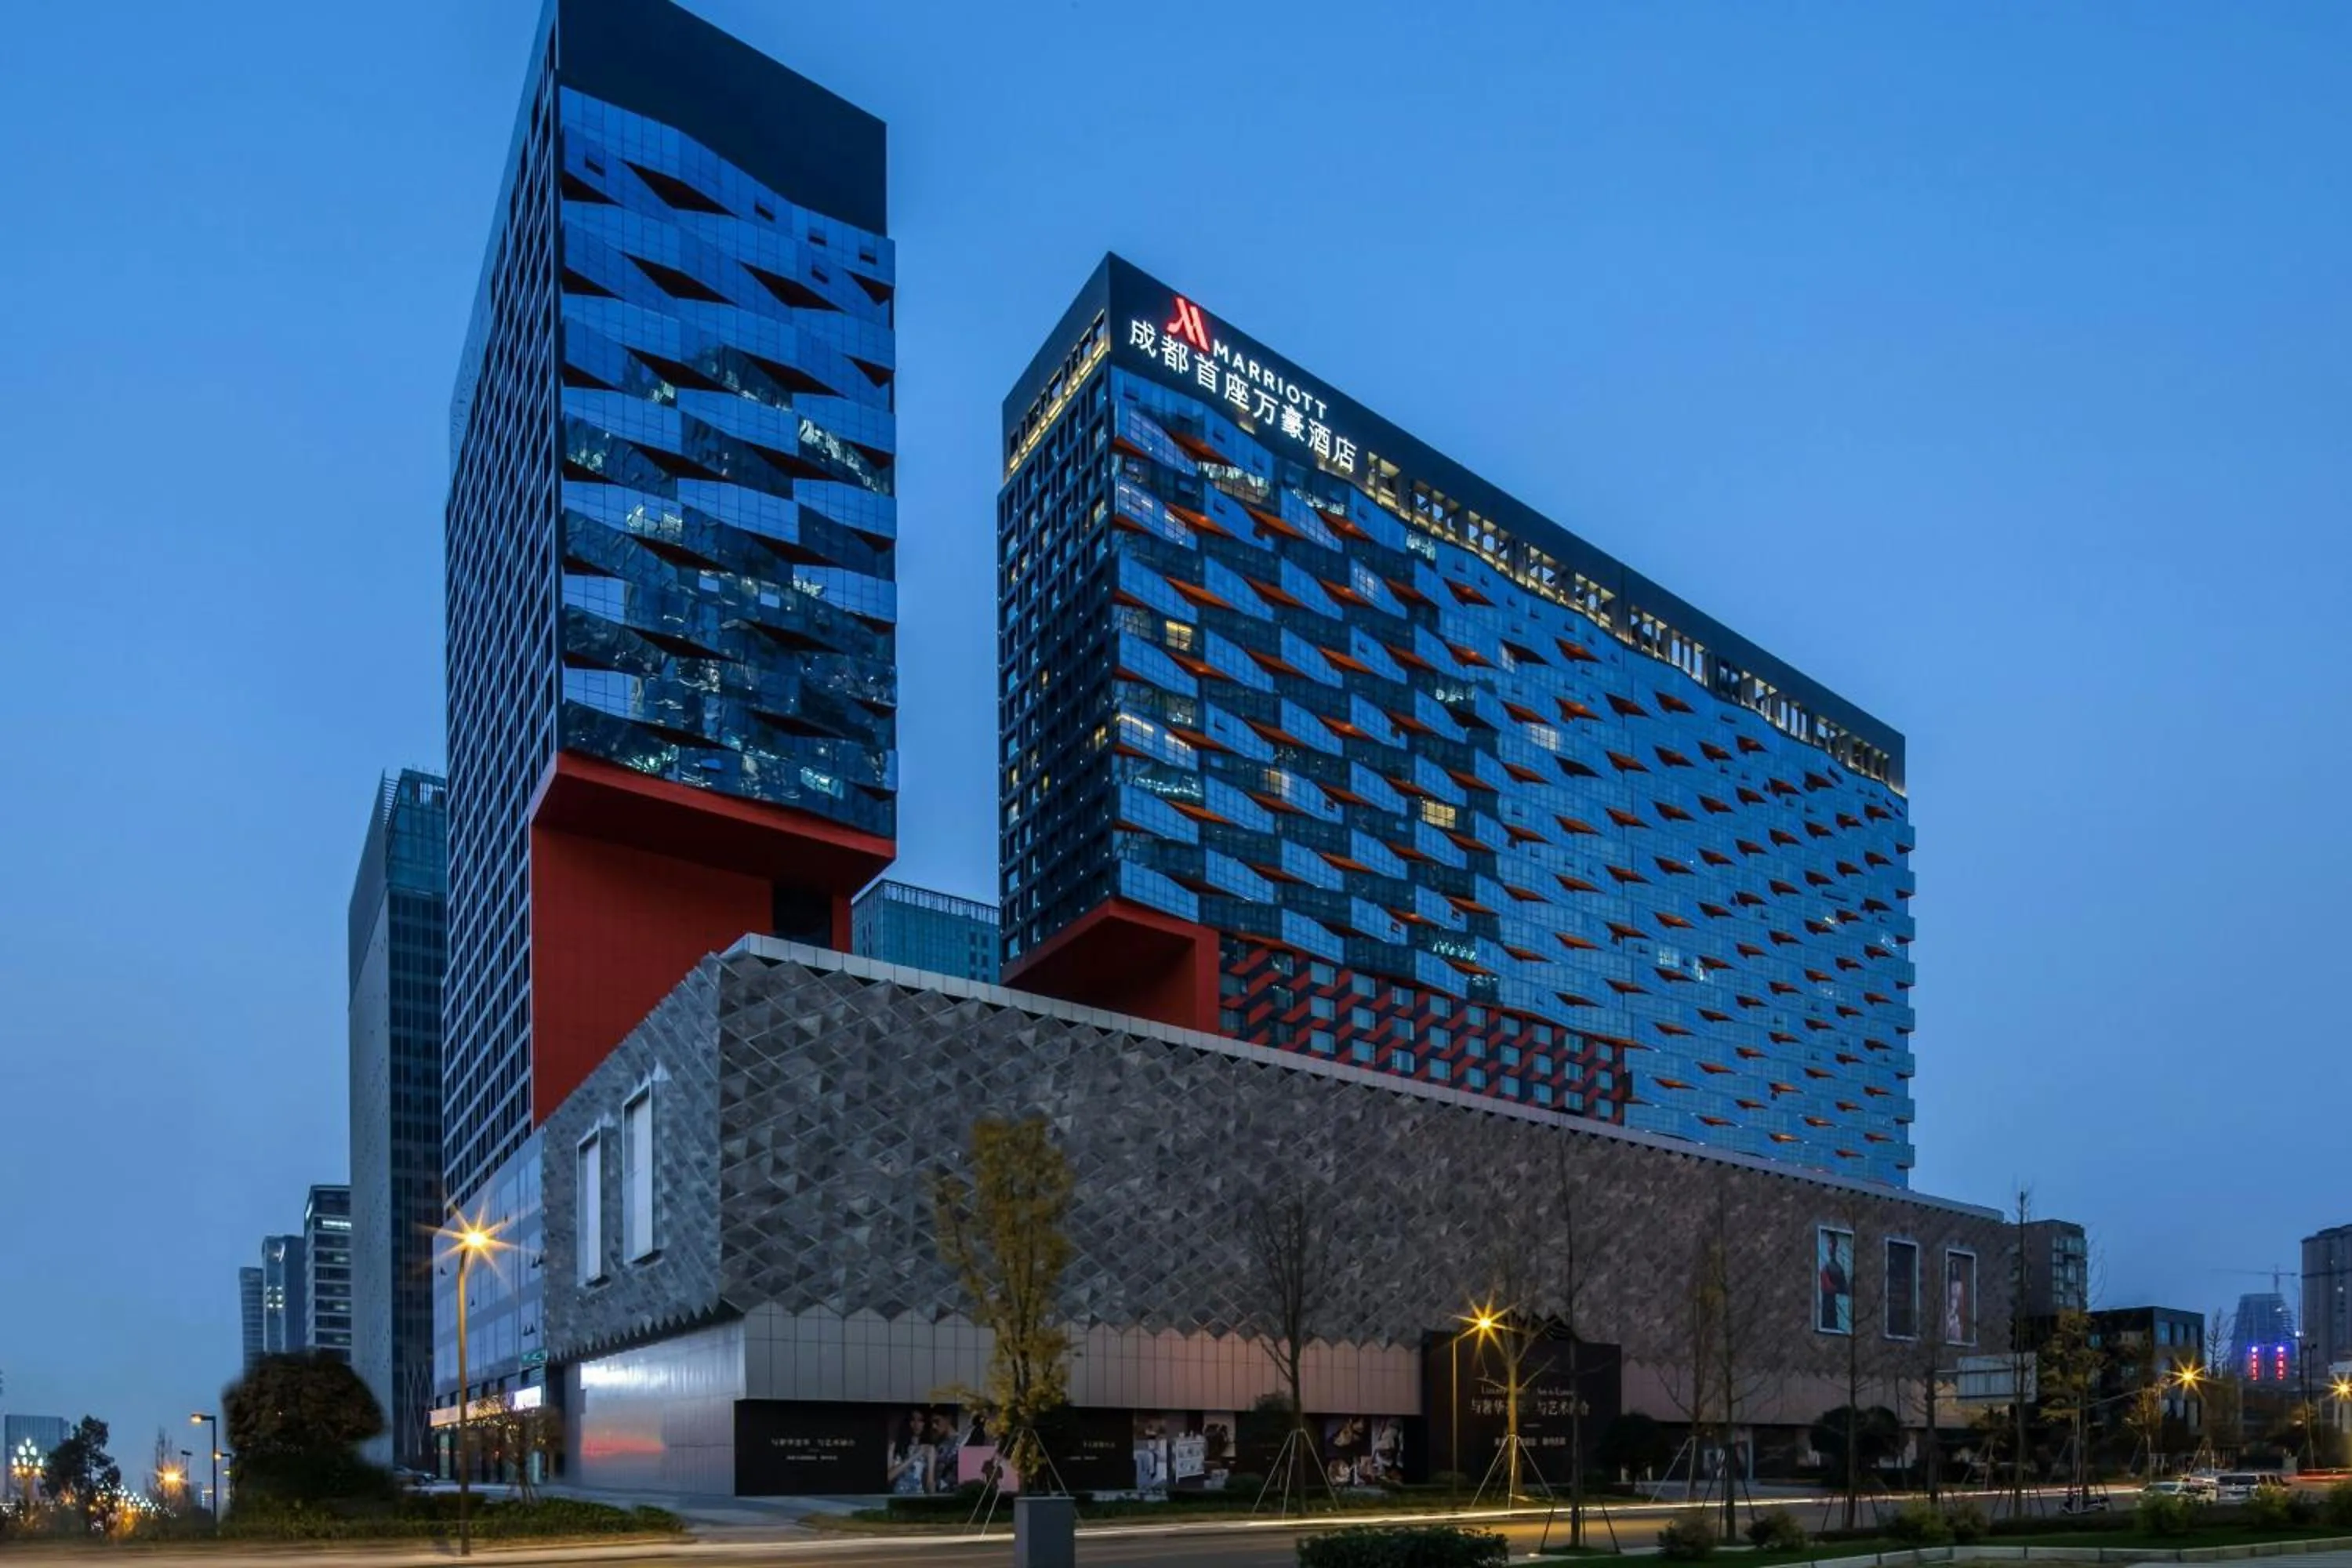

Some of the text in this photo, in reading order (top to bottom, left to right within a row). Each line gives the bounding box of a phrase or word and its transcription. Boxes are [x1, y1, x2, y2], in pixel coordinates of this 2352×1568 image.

[1129, 318, 1358, 474] 成都首座万豪酒店
[1212, 339, 1328, 419] MARRIOTT
